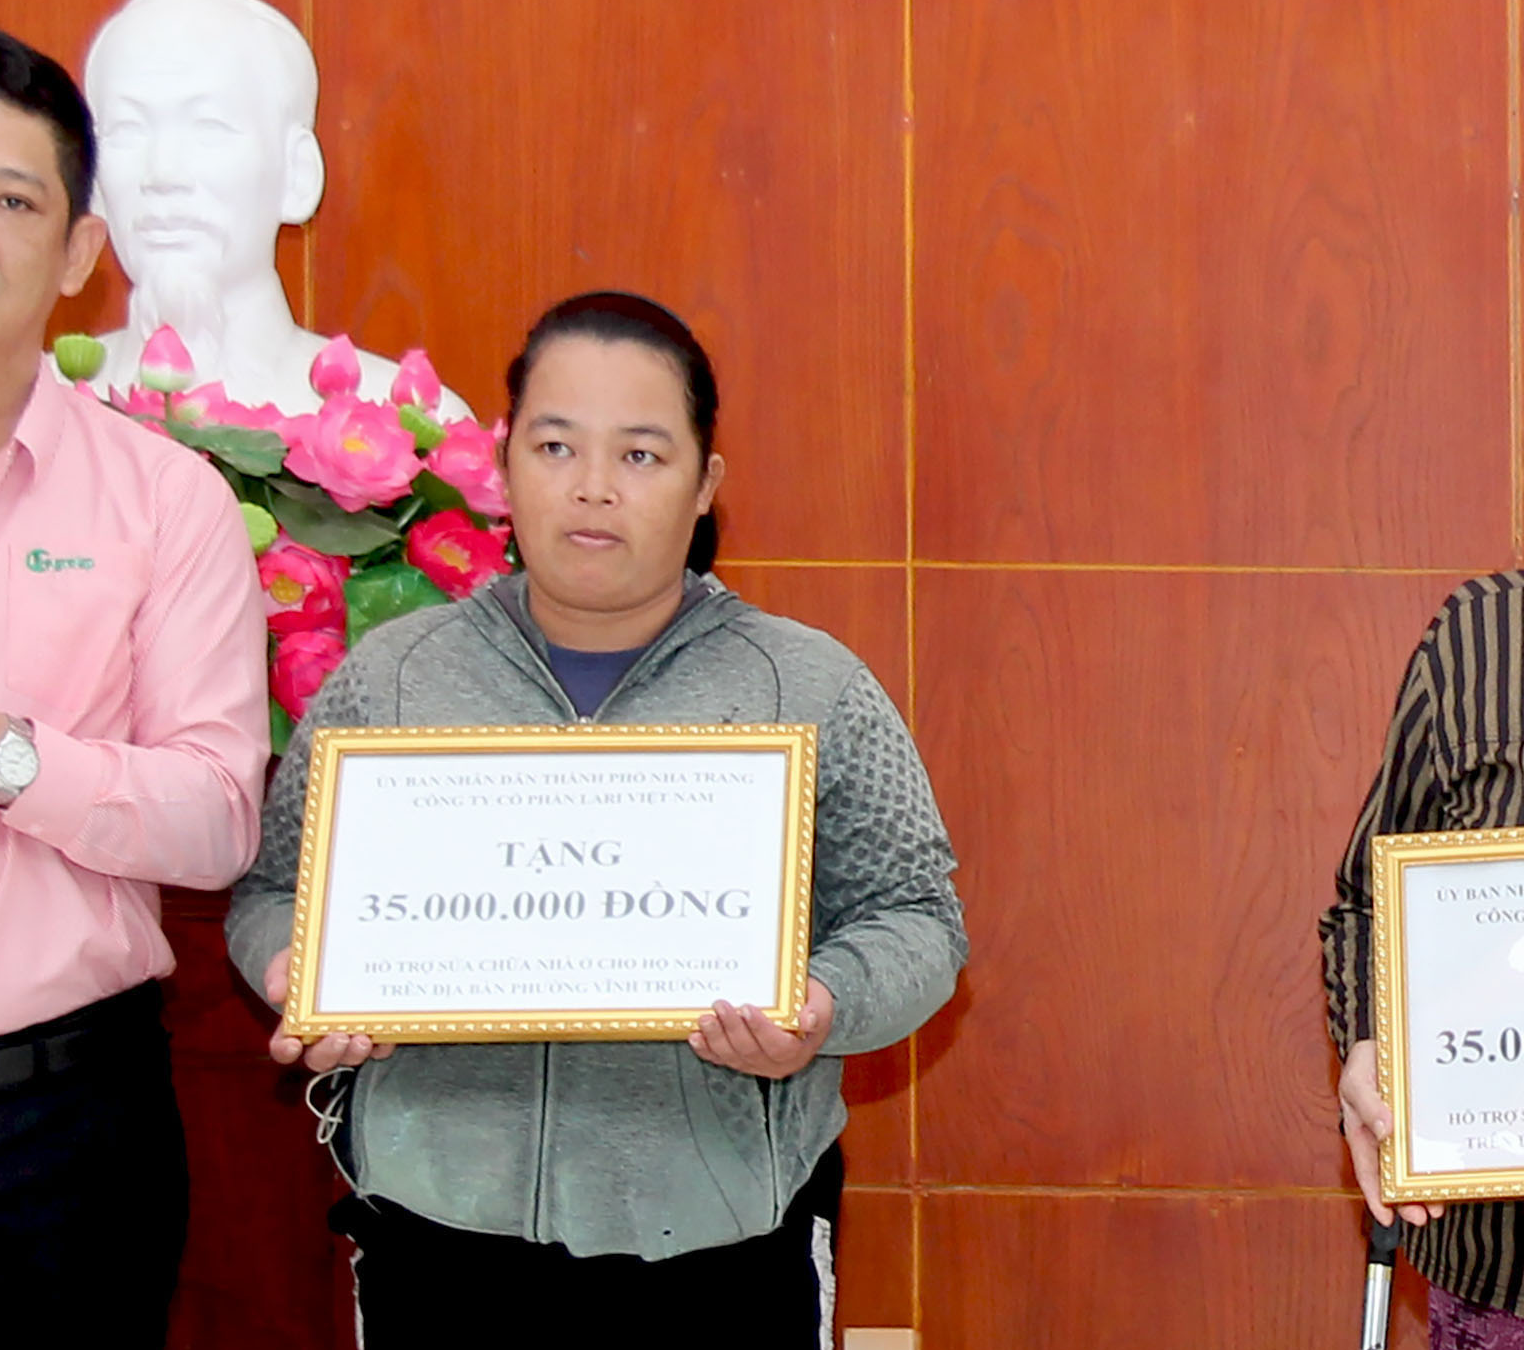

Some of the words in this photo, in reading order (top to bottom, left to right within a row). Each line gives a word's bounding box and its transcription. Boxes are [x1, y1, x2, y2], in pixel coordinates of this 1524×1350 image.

[496, 837, 624, 874] TẶNG
[357, 891, 586, 923] 35.000.000
[600, 880, 752, 920] ĐỒNG
[1466, 886, 1500, 900] BAN
[1480, 1110, 1519, 1126] TRỢ
